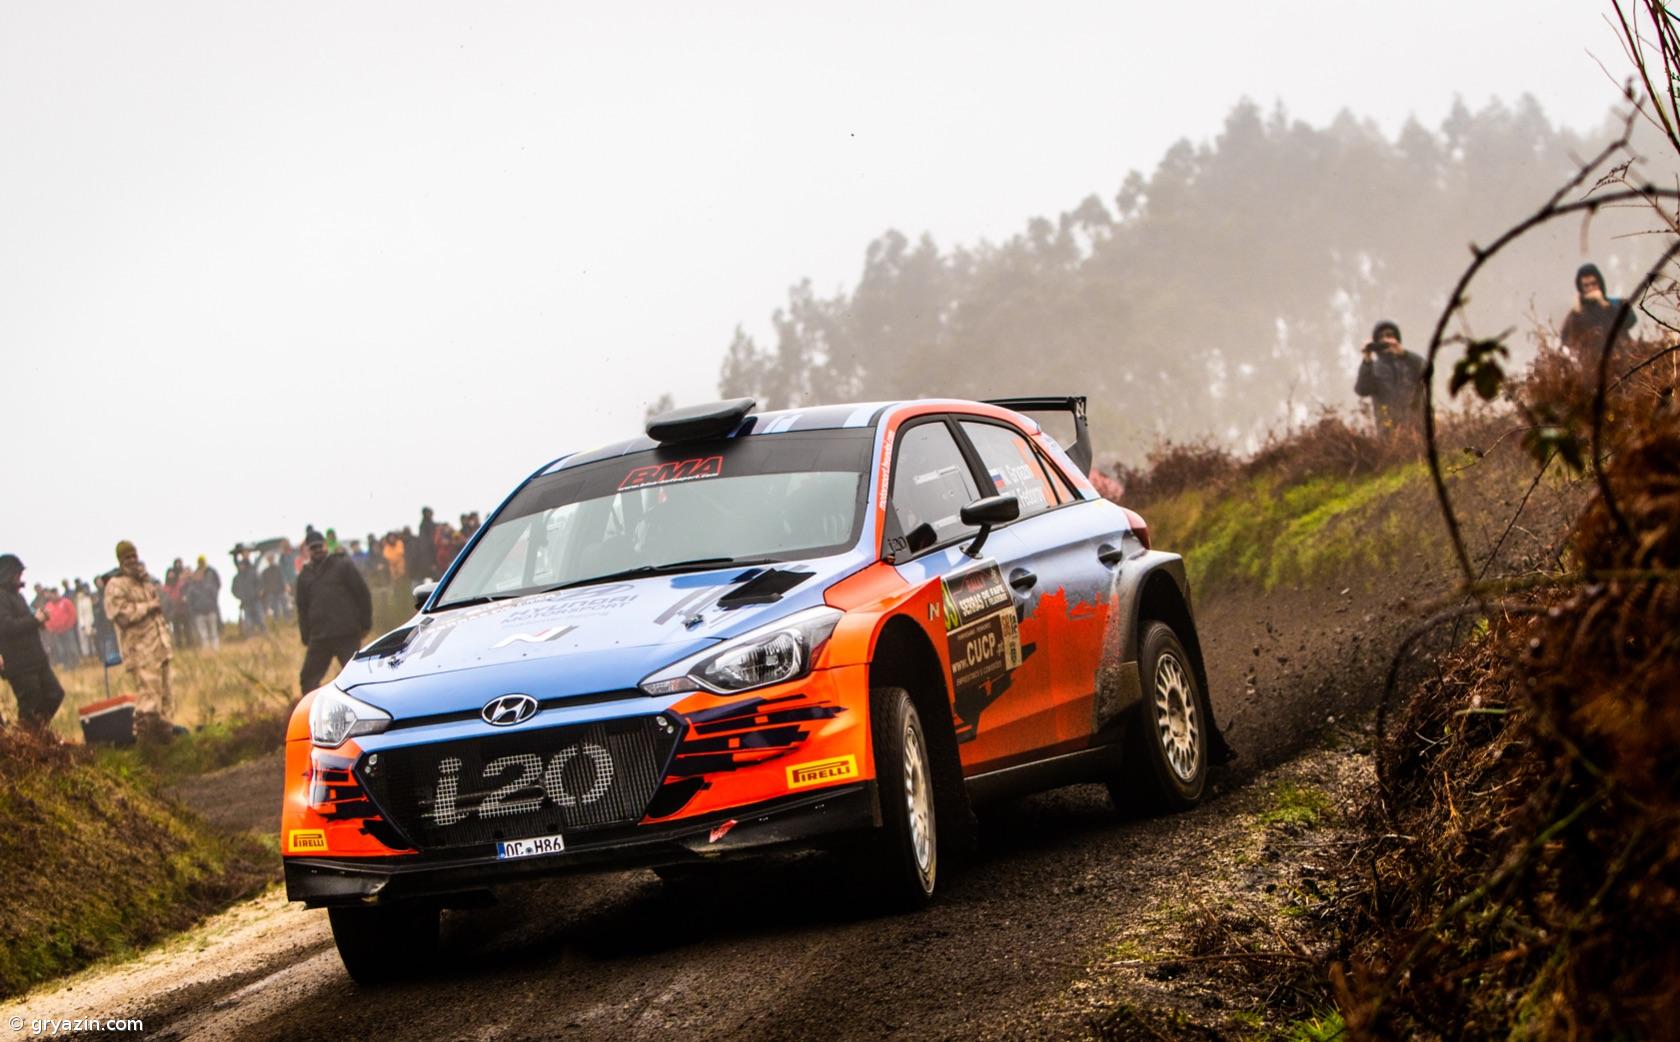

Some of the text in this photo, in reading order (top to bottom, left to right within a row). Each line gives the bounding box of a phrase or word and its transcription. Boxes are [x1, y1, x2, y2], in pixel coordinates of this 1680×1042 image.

[618, 456, 724, 489] BMA
[509, 594, 639, 618] HYUNDAI
[791, 760, 850, 783] PIRELLI
[433, 743, 615, 826] i20
[293, 833, 325, 848] PIRELLI
[533, 837, 562, 853] H86
